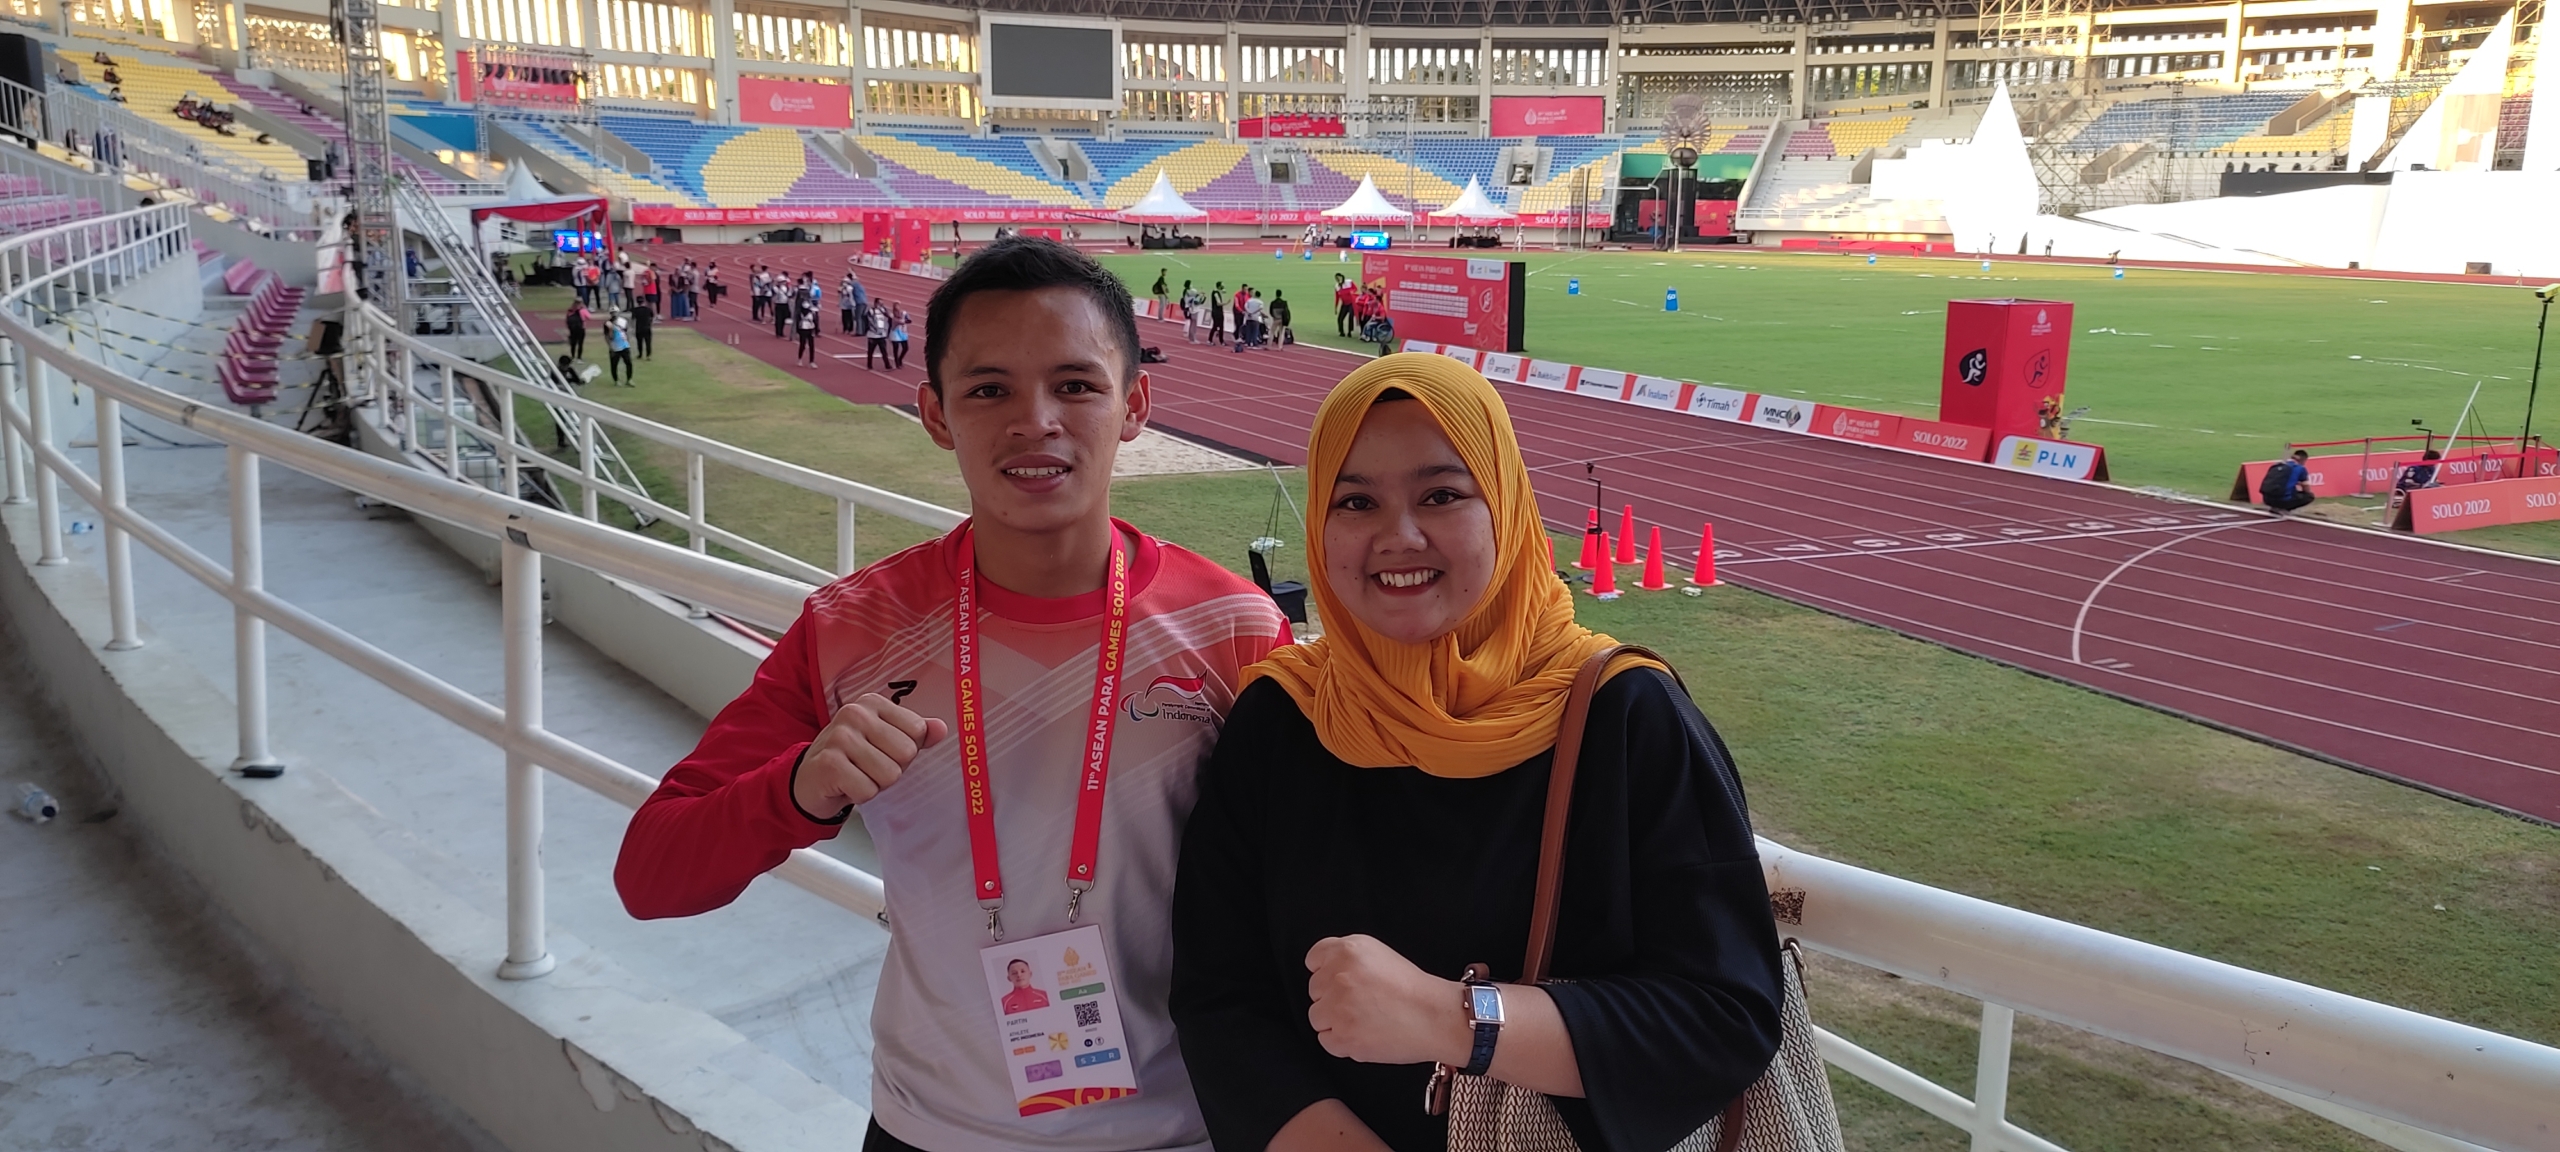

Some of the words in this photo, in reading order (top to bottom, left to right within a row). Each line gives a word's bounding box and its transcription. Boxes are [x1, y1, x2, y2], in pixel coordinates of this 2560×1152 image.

[964, 211, 985, 219] SOLO
[1279, 213, 1298, 221] 2022
[1535, 216, 1557, 224] SOLO
[1667, 293, 1677, 301] 60
[1648, 389, 1668, 401] Inalum
[1706, 399, 1730, 411] Timah
[1763, 407, 1787, 419] MNC
[1912, 430, 1941, 446] SOLO
[1941, 436, 1968, 450] 2022
[2037, 450, 2077, 469] PLN
[2449, 461, 2477, 474] SOLO
[2526, 492, 2557, 508] SOLO
[2432, 502, 2463, 519] SOLO
[2464, 499, 2492, 515] 2022
[1925, 533, 1979, 542] 5
[2000, 528, 2044, 537] 4
[1852, 539, 1901, 548] 6
[1115, 549, 1125, 580] 2022
[961, 568, 970, 585] 11th
[1113, 580, 1125, 617] SOLO
[959, 586, 970, 632] ASEAN
[1105, 620, 1122, 671] GAMES
[960, 635, 971, 676] PARA
[1098, 675, 1115, 716] PARA
[961, 678, 975, 732] GAMES
[1162, 709, 1210, 724] Indonesia
[1090, 720, 1108, 772] ASEAN
[965, 735, 980, 776] SOLO
[1087, 771, 1099, 791] 11th
[970, 780, 984, 816] 2022
[1006, 1018, 1028, 1026] PARTIN
[1009, 1029, 1029, 1037] ATHLETE
[1090, 1055, 1097, 1063] 2
